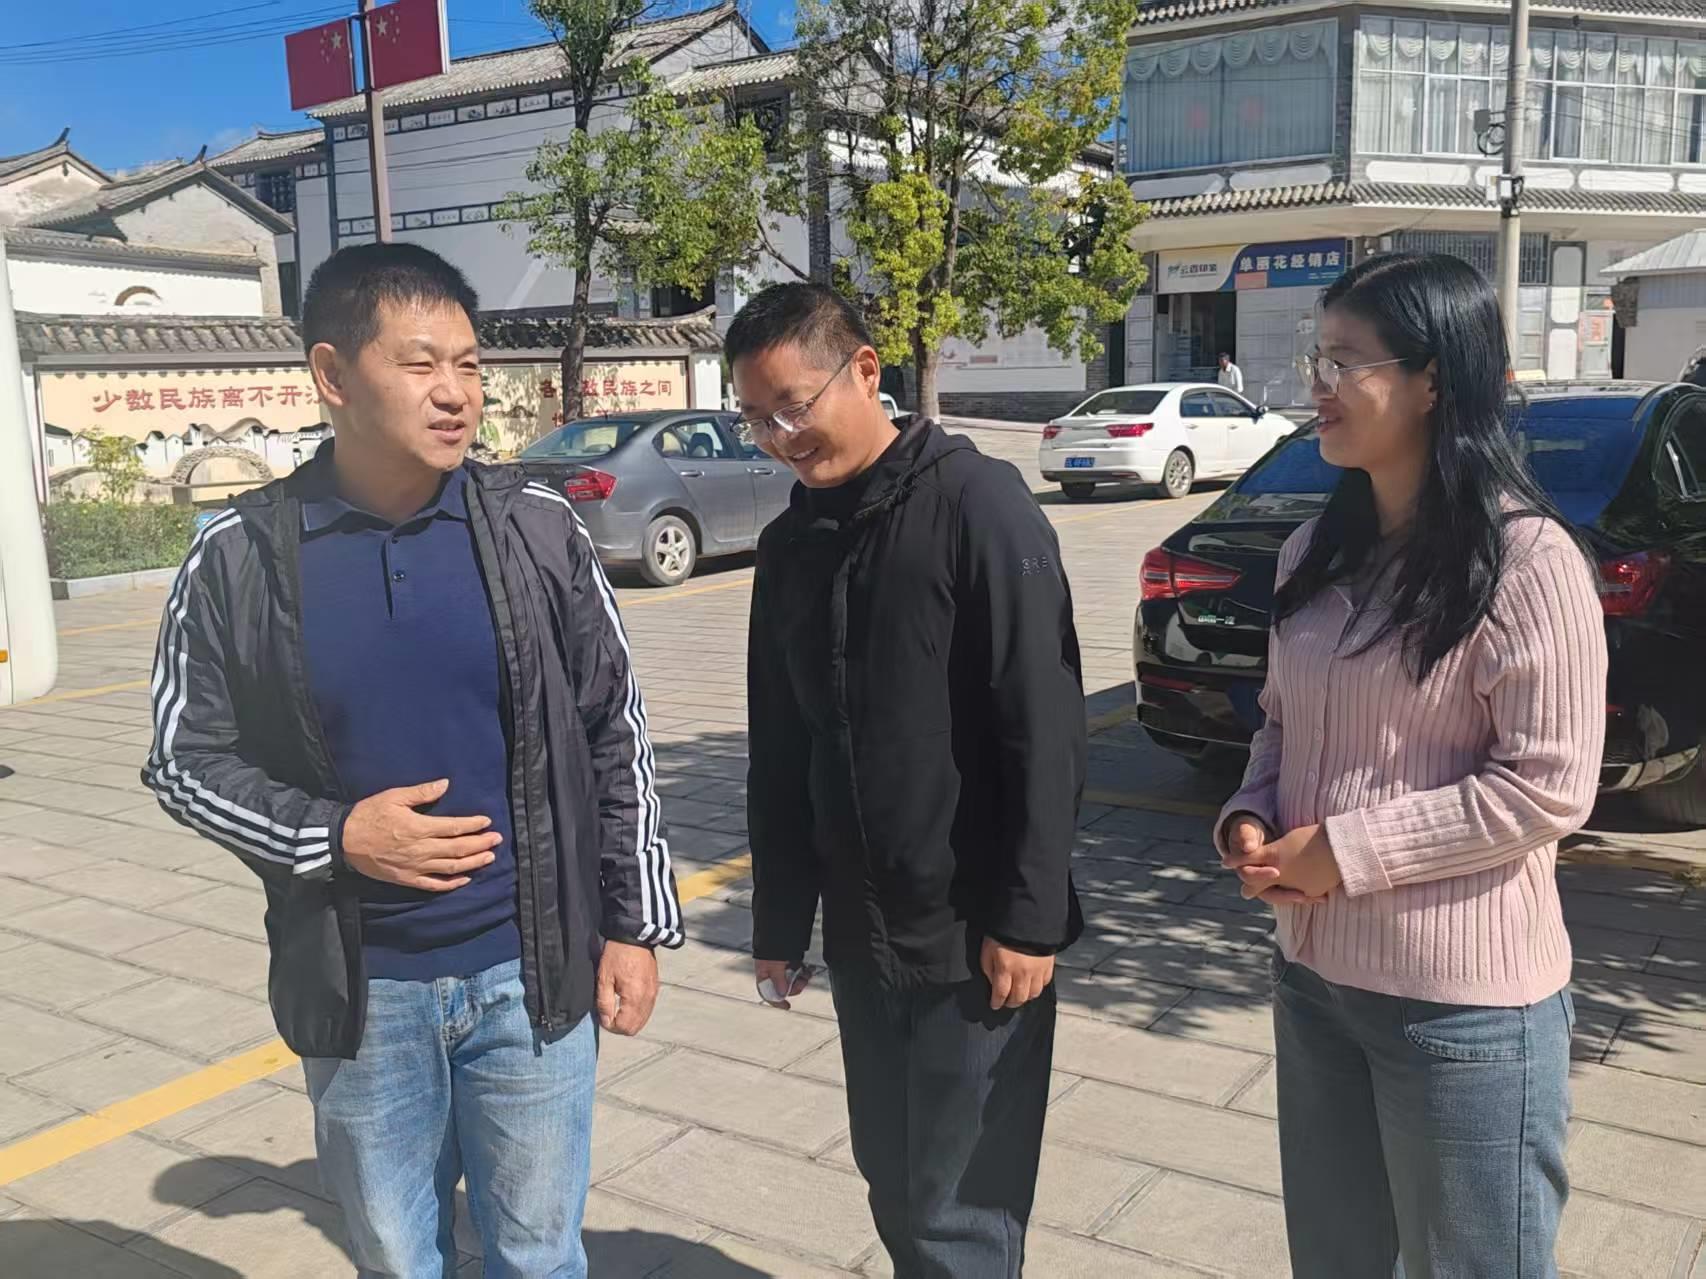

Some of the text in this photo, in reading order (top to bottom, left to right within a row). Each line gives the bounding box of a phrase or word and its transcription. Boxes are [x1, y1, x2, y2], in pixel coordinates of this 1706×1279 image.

[1239, 250, 1340, 272] 单丽花经销店
[540, 377, 673, 399] 各数民族之间
